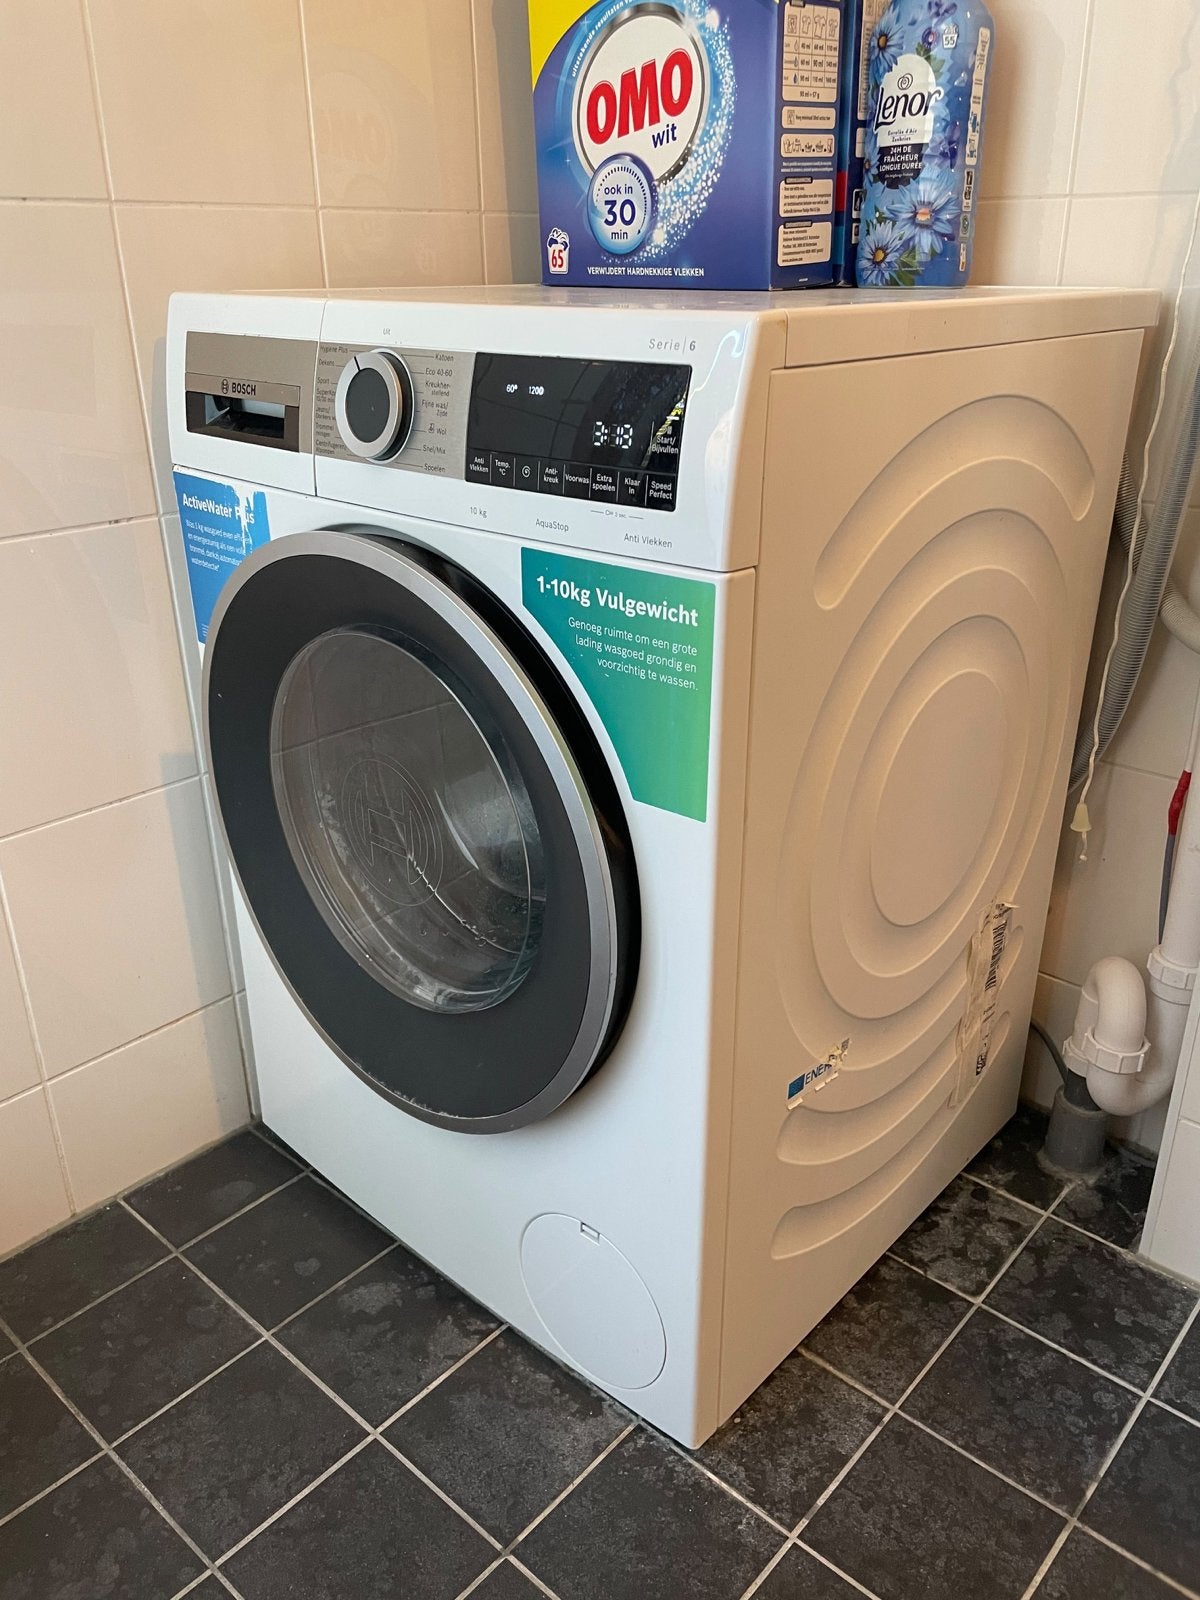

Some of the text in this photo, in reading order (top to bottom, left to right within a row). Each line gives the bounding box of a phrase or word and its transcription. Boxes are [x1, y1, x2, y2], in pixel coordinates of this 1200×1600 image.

[944, 37, 955, 47] 55
[587, 48, 693, 144] OMO
[874, 86, 943, 132] Lenor
[652, 123, 677, 149] wit
[890, 146, 901, 154] 24H
[884, 153, 919, 163] FRAÎCHEUR
[880, 160, 922, 172] LONGUE DURÉE
[604, 184, 633, 195] ook in
[604, 199, 636, 226] 30
[611, 229, 628, 239] min
[551, 249, 564, 268] 65
[587, 267, 704, 276] VERWIJDERT HARDNEKKIGE VLEKKEN
[649, 338, 696, 351] Serie 6
[426, 367, 435, 375] Eco
[231, 382, 256, 396] BOSCH
[528, 385, 544, 395] 1200
[657, 436, 676, 446] Start/
[652, 444, 679, 454] Bijvullen
[470, 464, 488, 473] Vlekken
[495, 460, 510, 468] Temp.
[543, 475, 559, 484] kreuk
[565, 473, 589, 484] Voorwas
[596, 474, 612, 483] Extra
[625, 478, 640, 487] Klaar
[592, 483, 615, 492] spoelen
[629, 487, 635, 495] in
[651, 481, 672, 491] Speed
[649, 490, 672, 500] Perfect
[183, 493, 255, 524] ActiveWater Pus
[470, 507, 487, 518] 10 kg
[535, 518, 569, 532] AquaStop
[624, 532, 673, 548] Anti Vlekken
[536, 576, 698, 627] 1-10kg Vulgewicht
[568, 617, 698, 656] Genoeg ruimte om een grote
[575, 634, 697, 673] lading wasgoed grondig en
[597, 658, 698, 691] voorzichtig te wassen.
